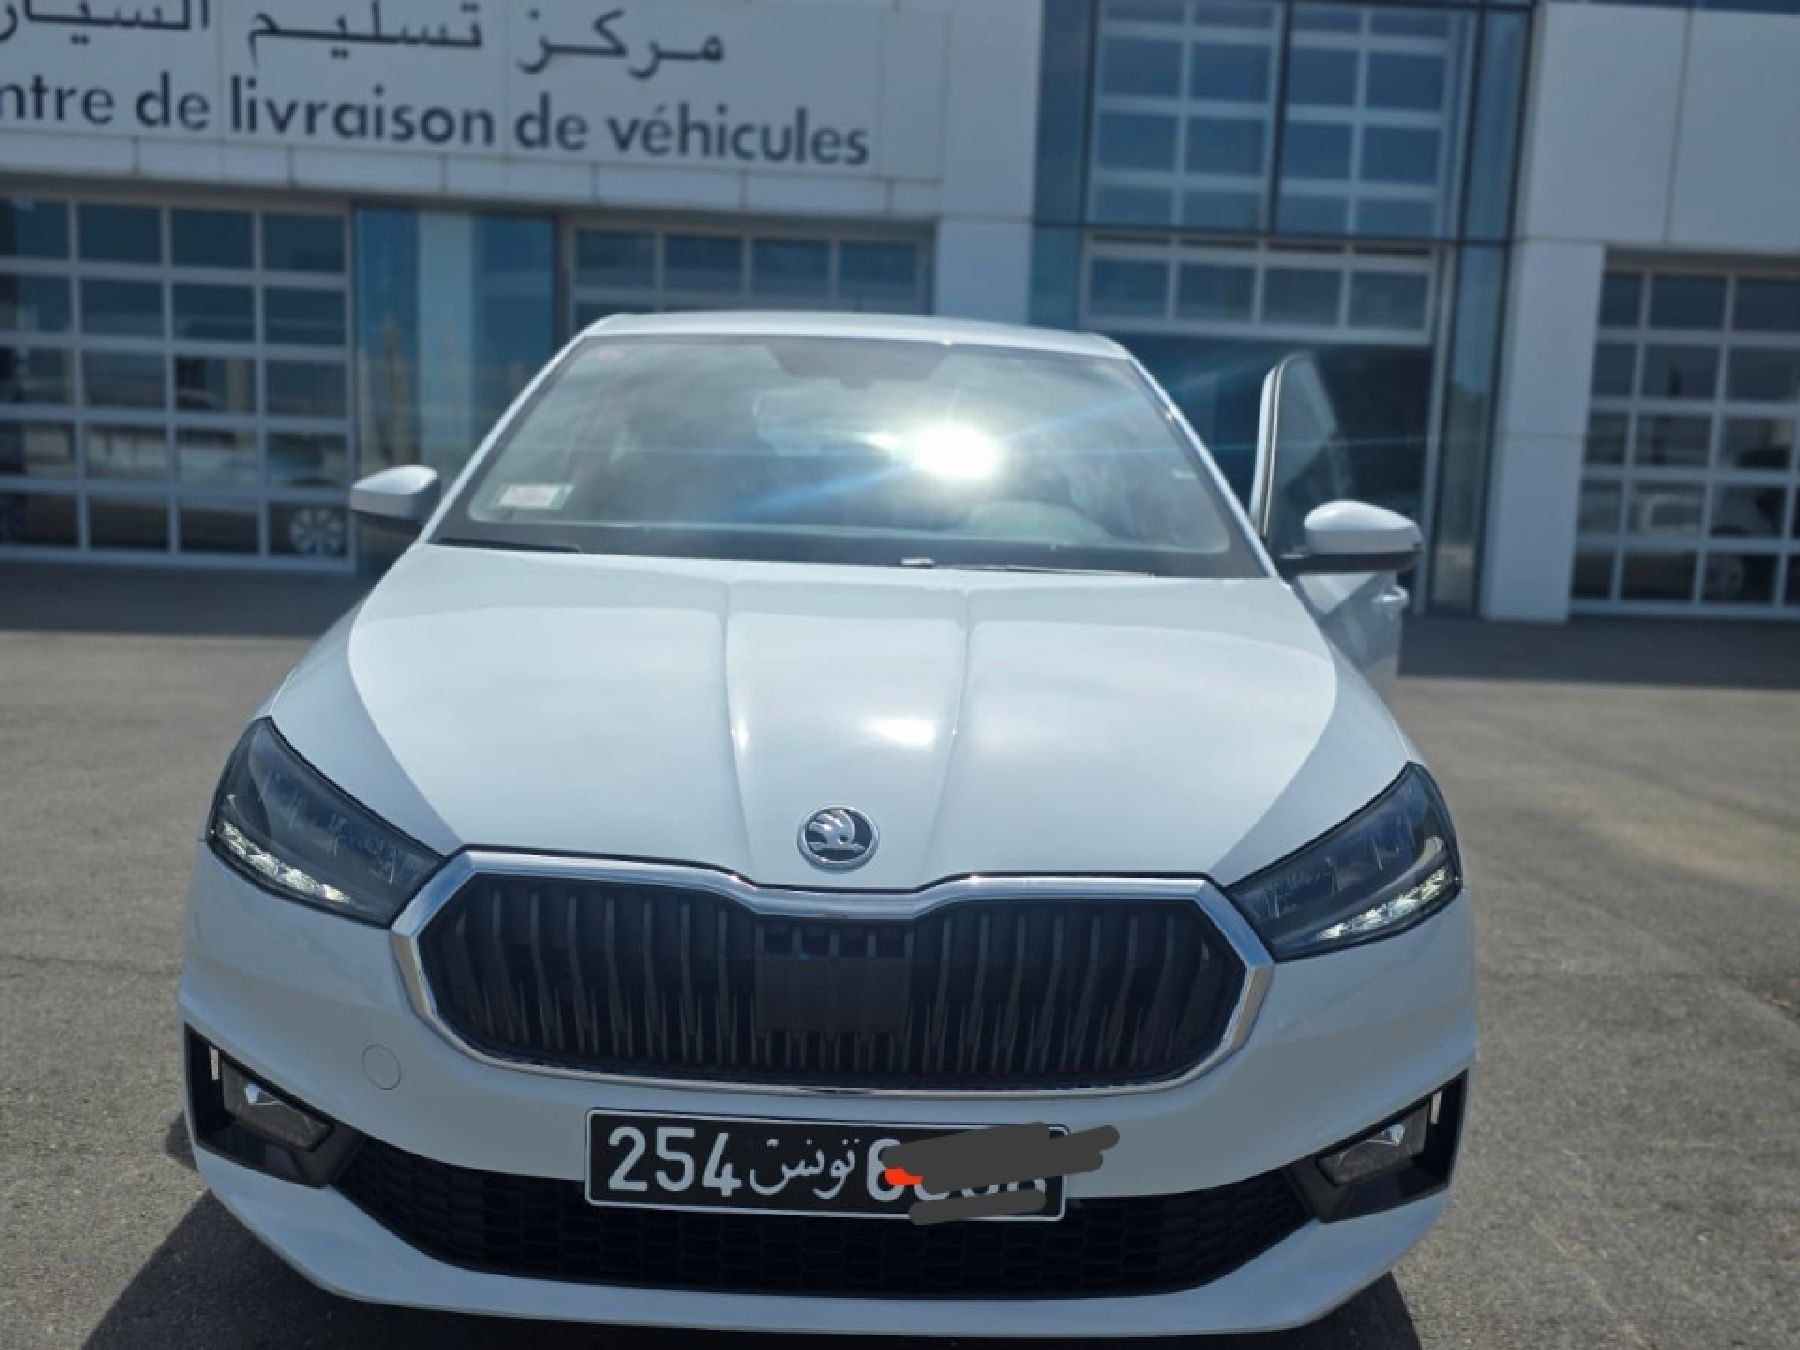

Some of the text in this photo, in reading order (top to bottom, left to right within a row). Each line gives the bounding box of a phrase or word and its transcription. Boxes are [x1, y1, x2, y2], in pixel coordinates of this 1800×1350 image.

[248, 0, 483, 68] تسليم
[515, 8, 724, 81] مركز
[134, 70, 212, 132] de
[231, 74, 495, 144] livraison
[514, 91, 590, 151] de
[605, 102, 872, 166] véhicules
[607, 1126, 742, 1197] 254
[749, 1137, 861, 1200] تونس
